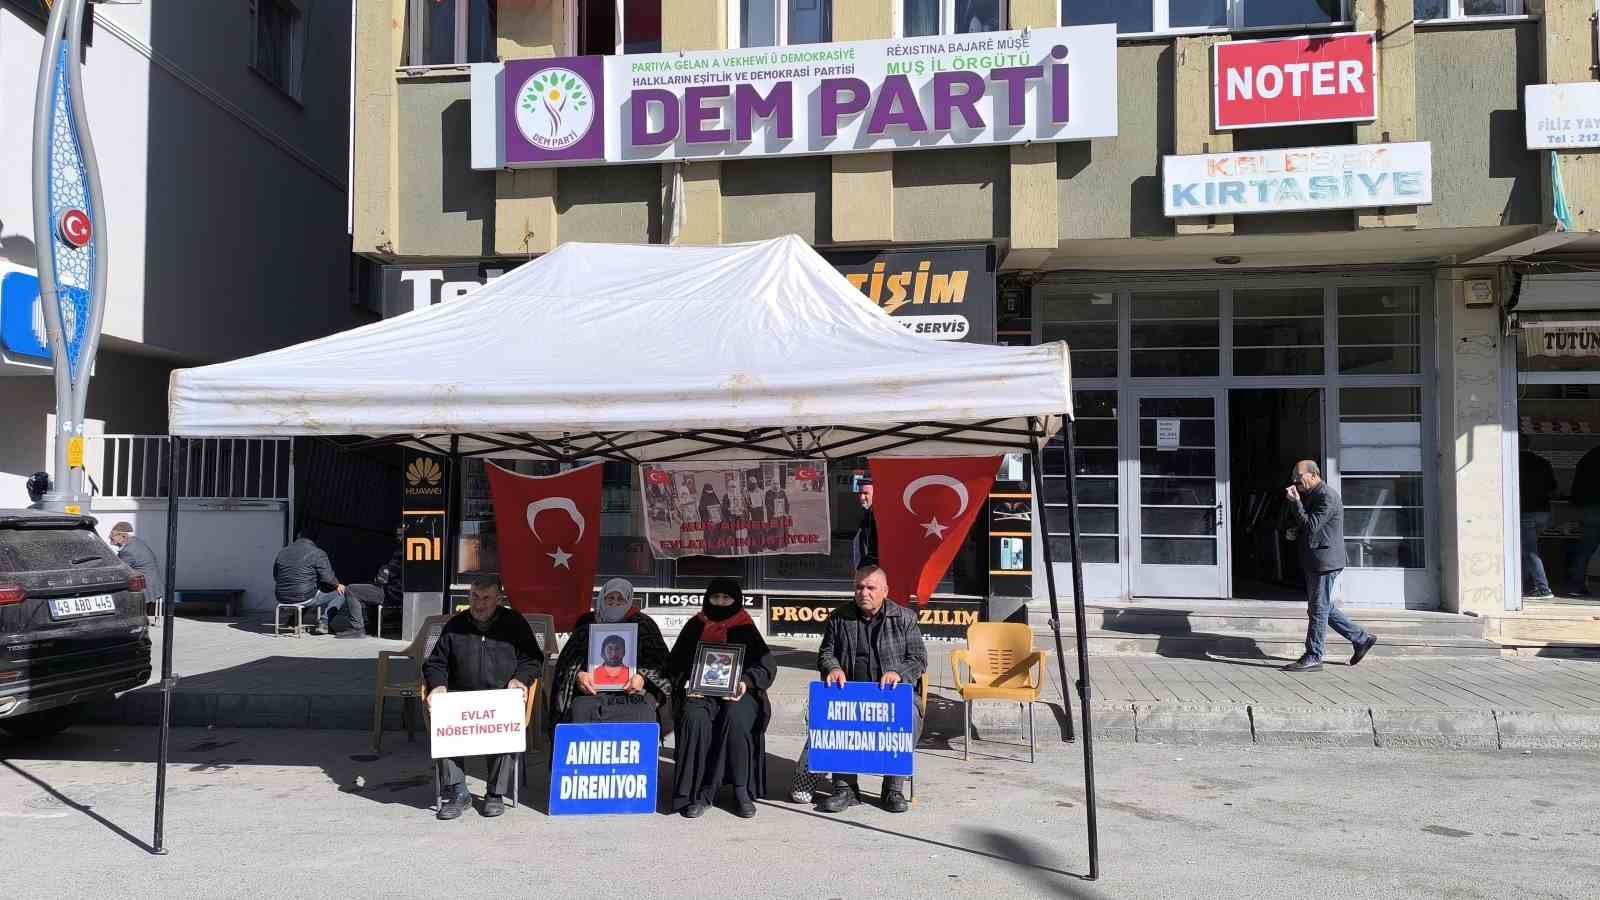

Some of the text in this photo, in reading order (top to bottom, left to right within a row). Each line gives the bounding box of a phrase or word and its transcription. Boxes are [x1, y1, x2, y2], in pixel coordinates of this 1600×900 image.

[948, 38, 994, 53] BAJARÊ
[674, 60, 709, 71] GELAN
[712, 58, 721, 68] A
[886, 51, 1031, 75] MUŞ İL ÖRGÜTÜ
[633, 63, 855, 87] HALKLARIN EŞİTLİK VE DEMOKRASİ PARTİSİ
[1226, 59, 1365, 101] NOTER
[631, 44, 1069, 146] DEM PARTİ
[532, 132, 551, 147] DEM
[1547, 133, 1567, 144] Tel
[1172, 169, 1425, 208] KIRTASİYE
[915, 318, 966, 334] SERVİS
[405, 487, 442, 496] HUAWEI
[58, 600, 70, 613] 49
[96, 595, 112, 609] 445
[461, 708, 497, 721] EVLAT
[827, 700, 857, 721] ARTIK
[859, 701, 889, 722] YETER
[436, 722, 521, 737] NÖBETİNDEYİZ
[809, 726, 913, 758] YAKAMIZDAN DÜŞÜN
[565, 740, 641, 765] ANNELER
[560, 768, 648, 800] DİRENİYOR
